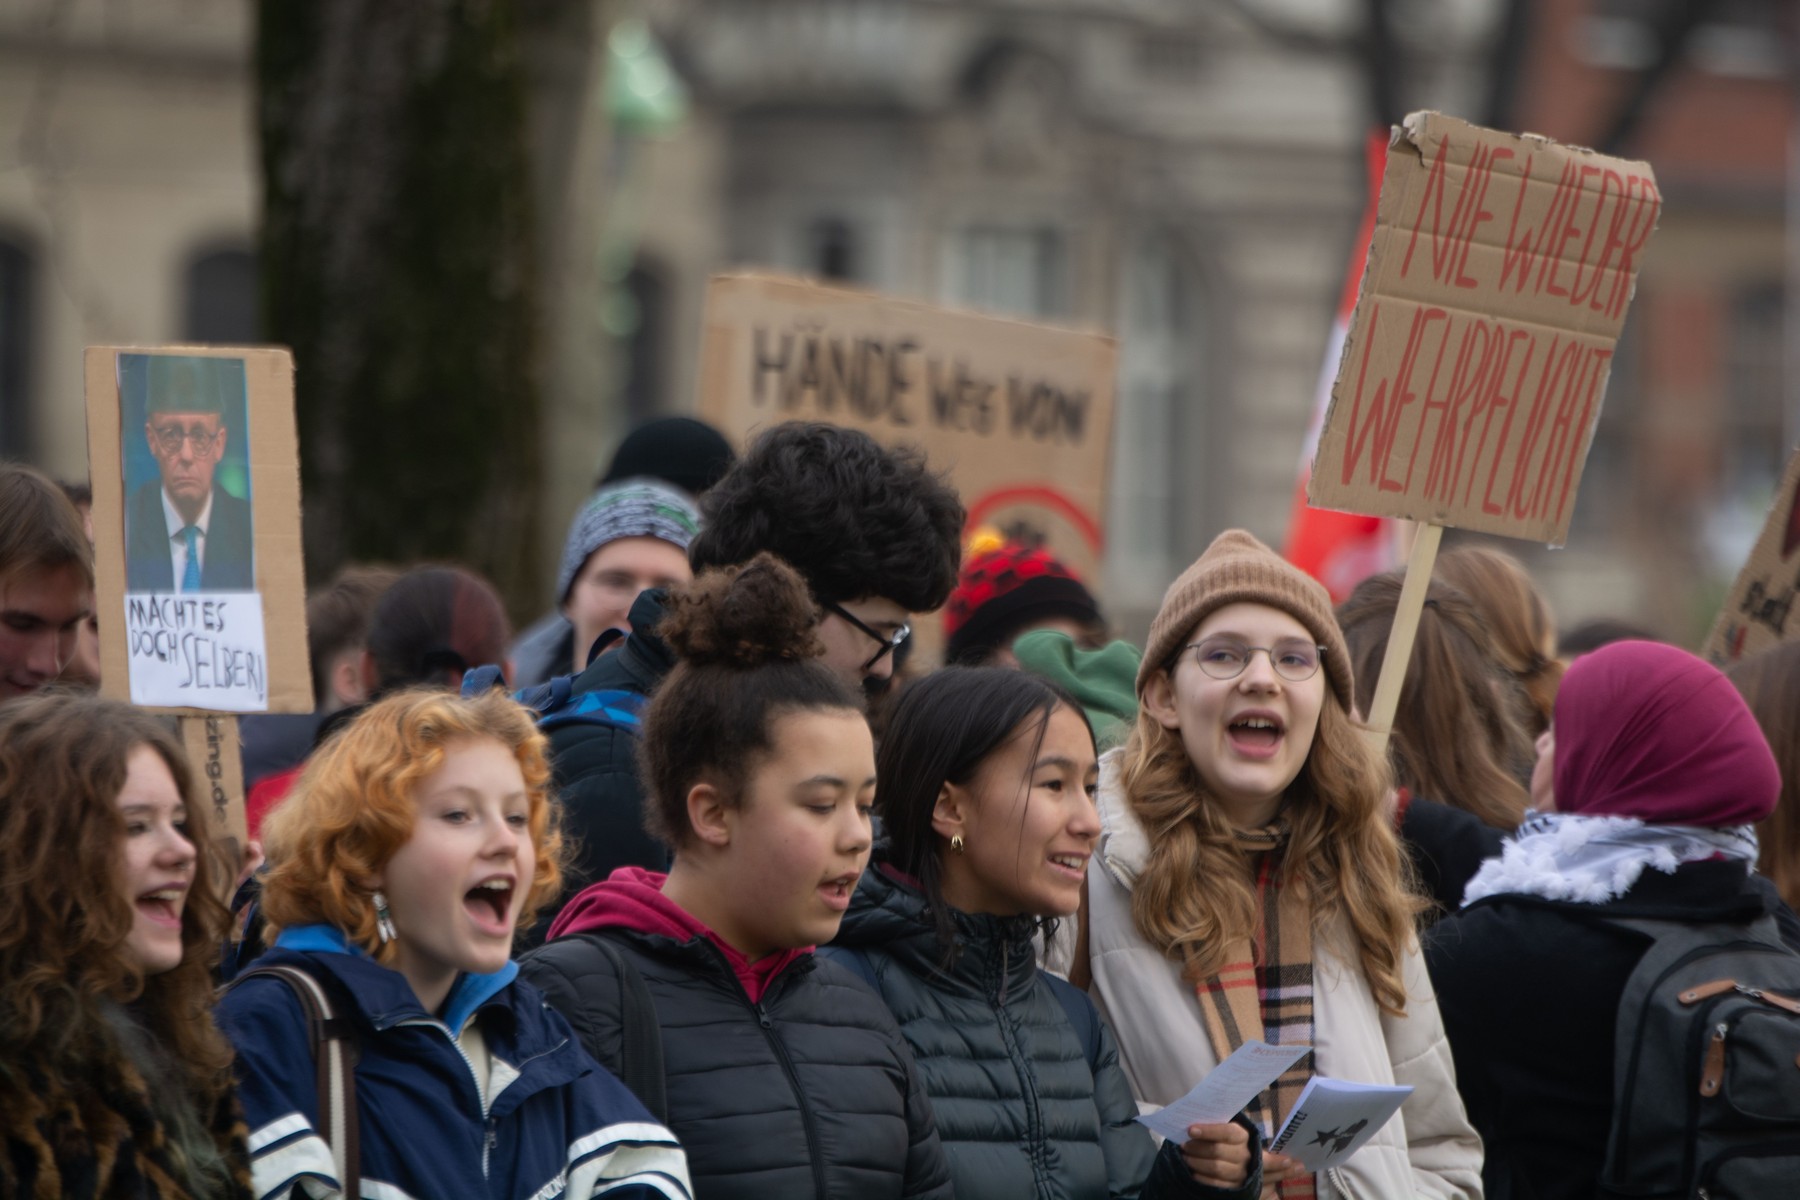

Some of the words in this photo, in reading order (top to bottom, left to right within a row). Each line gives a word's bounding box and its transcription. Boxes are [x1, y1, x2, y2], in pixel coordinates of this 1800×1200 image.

[1401, 134, 1514, 289] NIE
[1499, 152, 1661, 322] WIEDER
[753, 321, 920, 426] HÄNDE
[1006, 375, 1092, 448] VON
[1340, 302, 1614, 527] WEHRPFLICHT
[131, 628, 178, 665] DOCH
[178, 631, 264, 703] SELBER!
[1270, 1110, 1308, 1155] ukunft!
